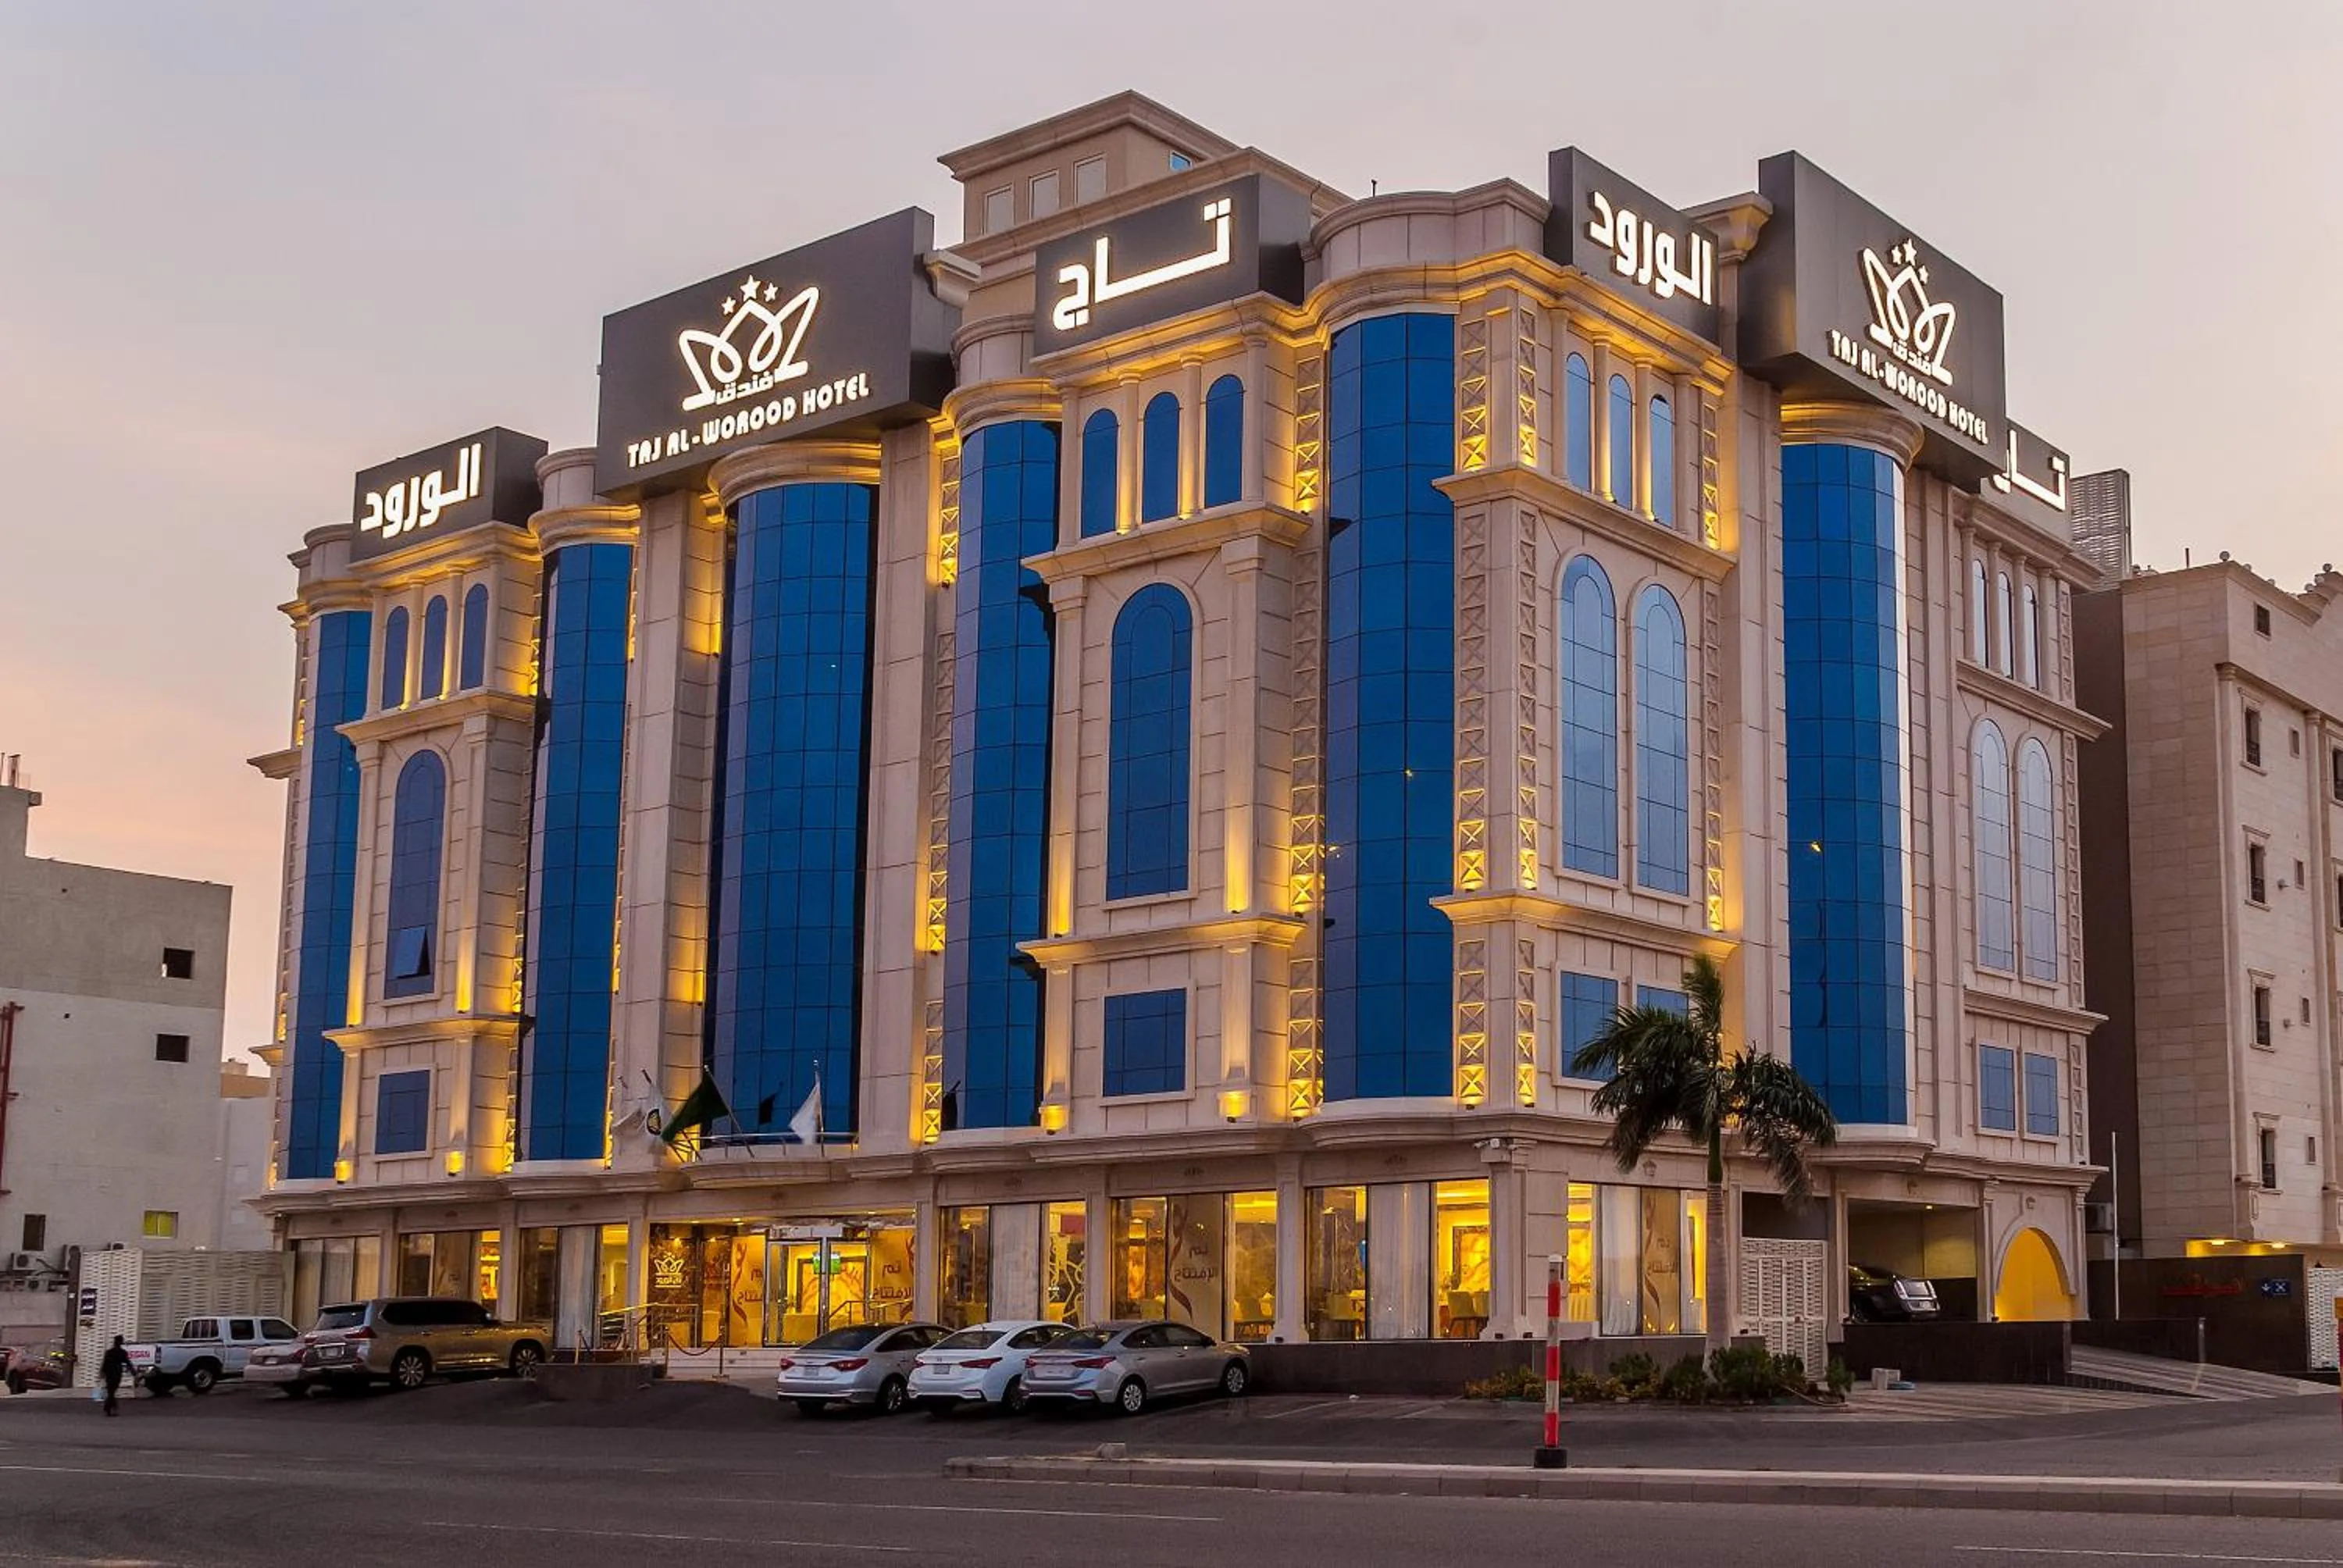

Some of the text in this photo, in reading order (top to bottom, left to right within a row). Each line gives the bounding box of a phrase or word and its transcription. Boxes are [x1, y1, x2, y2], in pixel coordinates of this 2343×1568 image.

[1053, 198, 1232, 330] تاج
[1590, 191, 1711, 305] الورود
[628, 437, 662, 468] TAJ
[802, 372, 869, 415] HOTEL
[716, 371, 774, 405] فندق
[1832, 329, 1858, 365] TAJ
[1949, 401, 1988, 444] HOTEL
[360, 443, 482, 539] الورود
